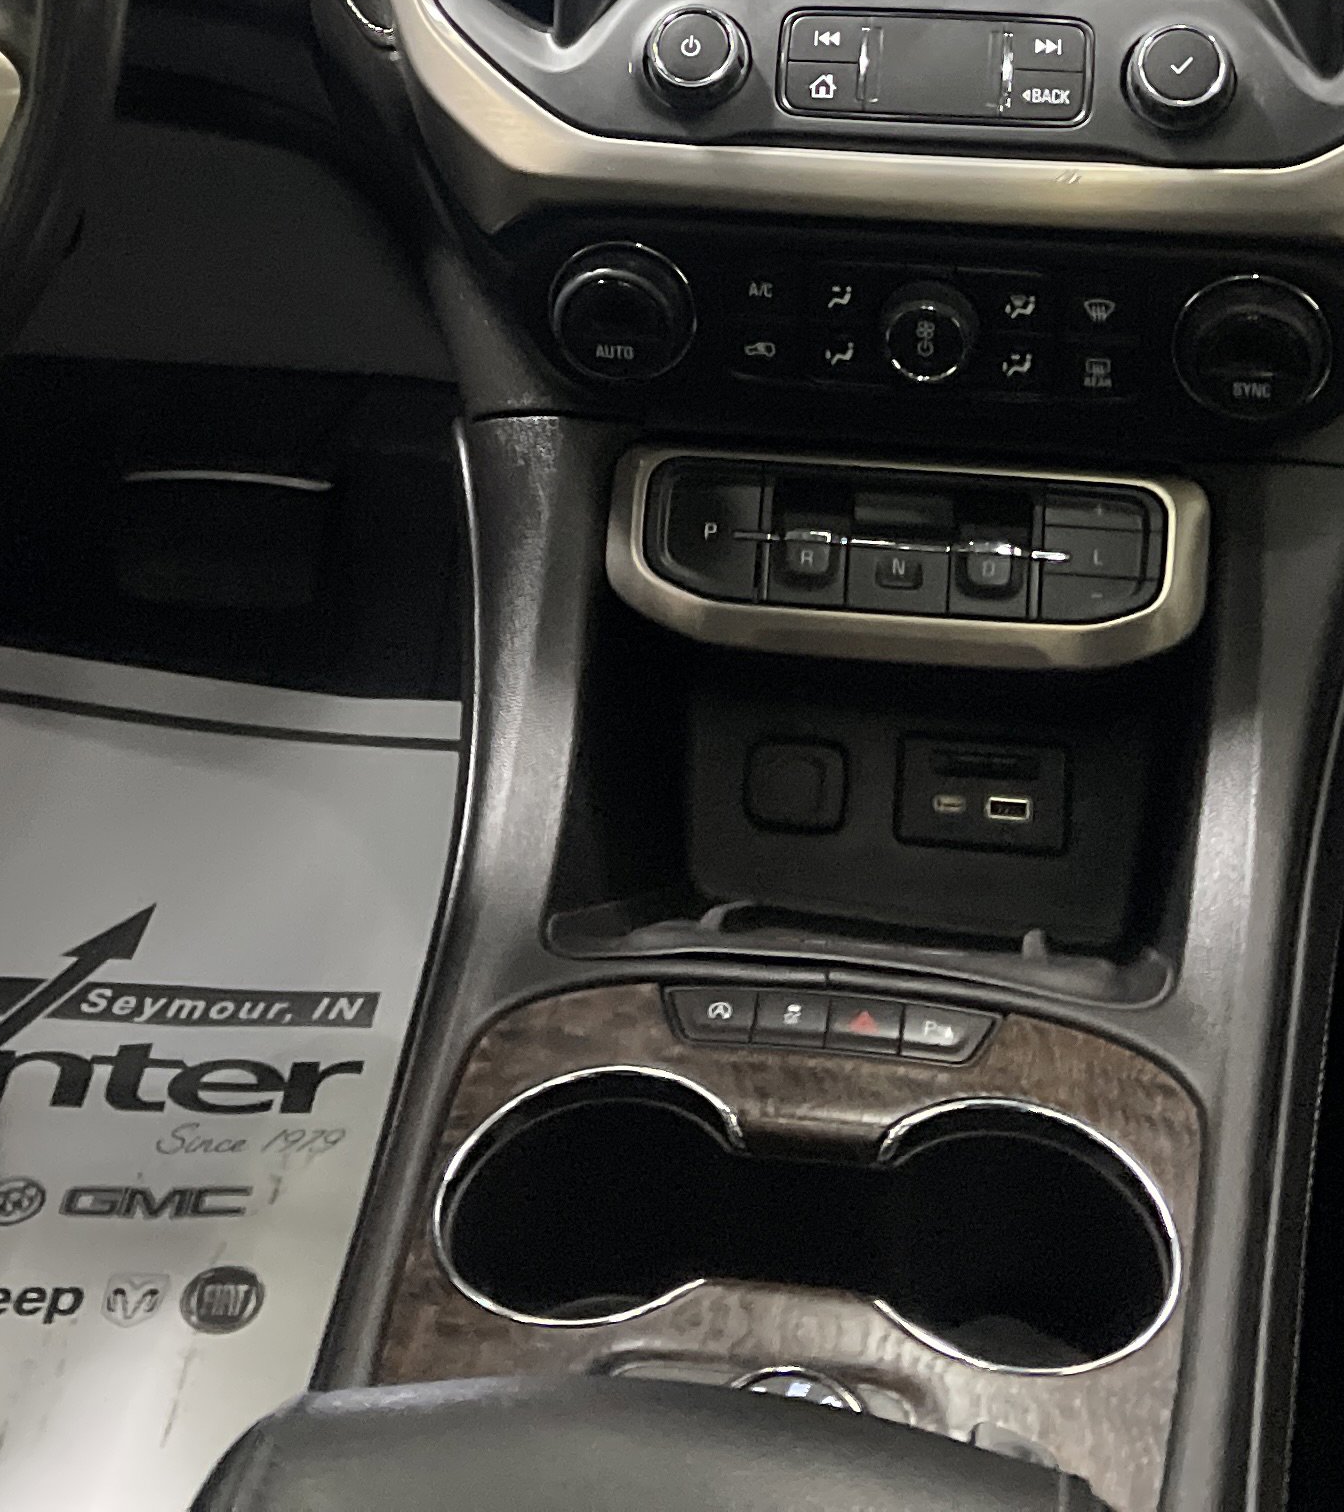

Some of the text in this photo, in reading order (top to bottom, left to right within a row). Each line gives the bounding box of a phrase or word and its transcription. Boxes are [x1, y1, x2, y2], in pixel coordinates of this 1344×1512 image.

[1031, 88, 1071, 105] BACK
[748, 282, 774, 298] A/C
[595, 344, 635, 360] AUTO
[1232, 382, 1272, 399] SYNC
[703, 521, 718, 541] P
[799, 548, 814, 565] R
[1093, 549, 1104, 567] L
[891, 557, 906, 576] N
[981, 560, 996, 578] D
[79, 987, 365, 1024] Seymour, IN
[155, 1122, 347, 1156] Since 1979
[58, 1185, 255, 1221] GMC
